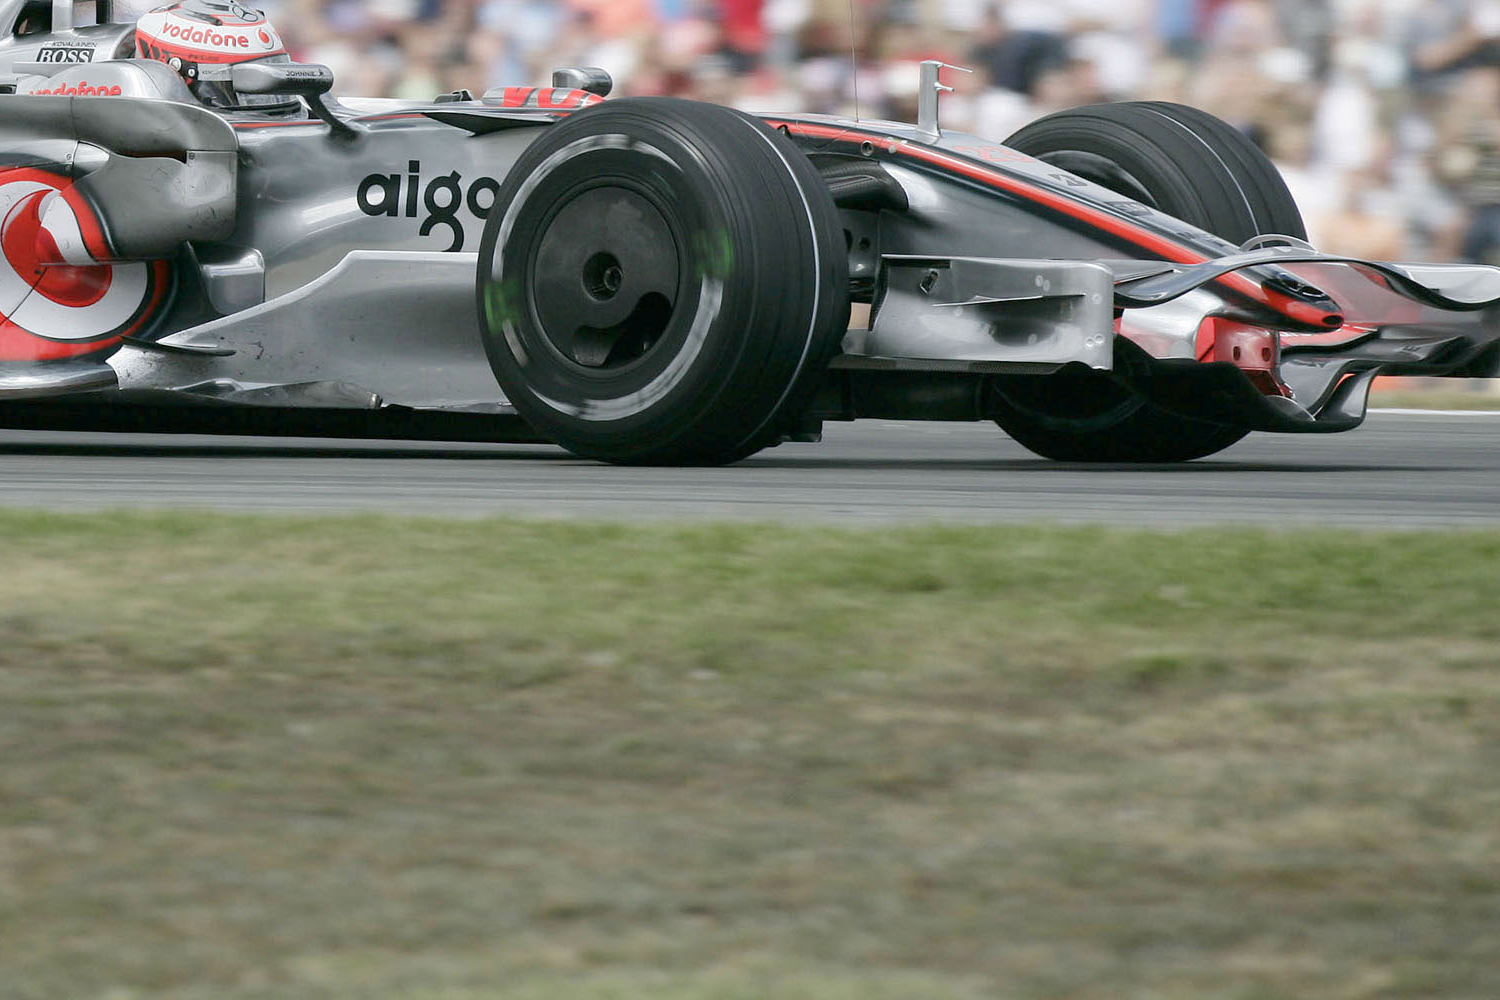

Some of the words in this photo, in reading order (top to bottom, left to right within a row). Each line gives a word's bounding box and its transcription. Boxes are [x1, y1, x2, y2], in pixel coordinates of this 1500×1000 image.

[162, 22, 250, 48] vodafone
[39, 49, 91, 63] BOSS
[356, 160, 500, 253] aigo
